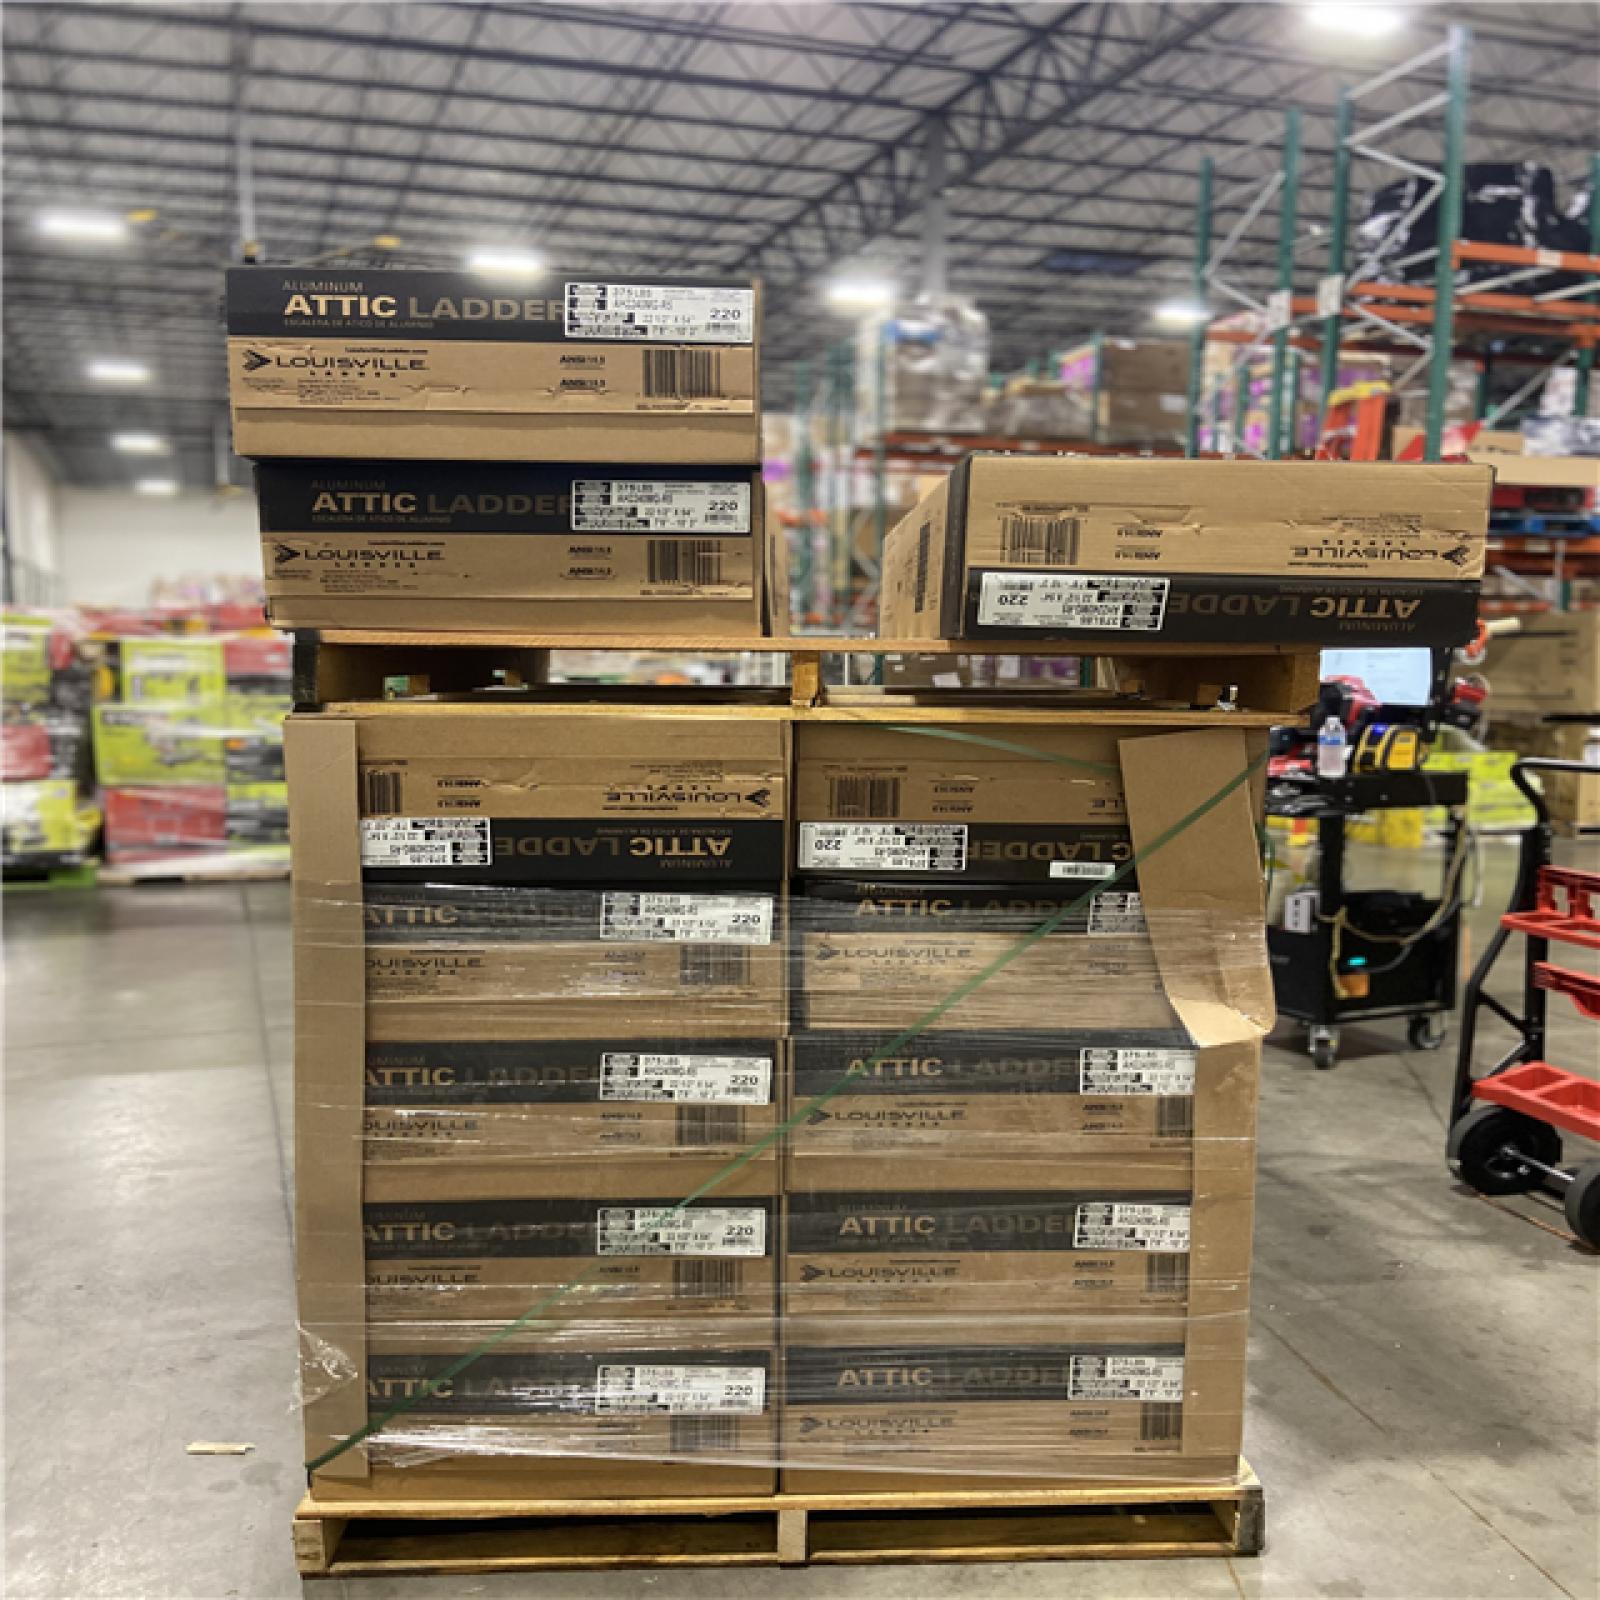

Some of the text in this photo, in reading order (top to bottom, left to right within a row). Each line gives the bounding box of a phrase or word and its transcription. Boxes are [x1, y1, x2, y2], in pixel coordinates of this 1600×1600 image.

[284, 294, 399, 318] ATTIC
[709, 308, 741, 321] 220
[277, 355, 430, 370] LOUISVILLE
[313, 492, 417, 513] ATTIC
[709, 500, 739, 511] 220
[304, 549, 445, 561] LOUISVILLE
[1289, 547, 1439, 561] LOUISVILLE
[998, 594, 1029, 606] 220
[1167, 594, 1421, 618] ATTIC LADDE
[602, 791, 741, 803] LOUISVILLE
[495, 836, 732, 856] ATTIC LADDE
[814, 839, 842, 851] 220
[854, 899, 952, 917] ATTIC
[731, 914, 761, 924] 220
[844, 949, 974, 958] LOUISVILLE
[365, 957, 486, 968] OUISVILLE
[846, 1057, 944, 1076] ATTIC
[729, 1074, 759, 1085] 220
[835, 1109, 969, 1121] LOUISVILLE
[365, 1119, 479, 1130] OUISVILLE
[724, 1224, 755, 1236] 220
[839, 1215, 936, 1236] ATTIC
[830, 1266, 960, 1278] LOUISVILLE
[365, 1274, 481, 1285] OUISVILLE
[836, 1366, 933, 1387] ATTIC
[724, 1384, 753, 1396] 220
